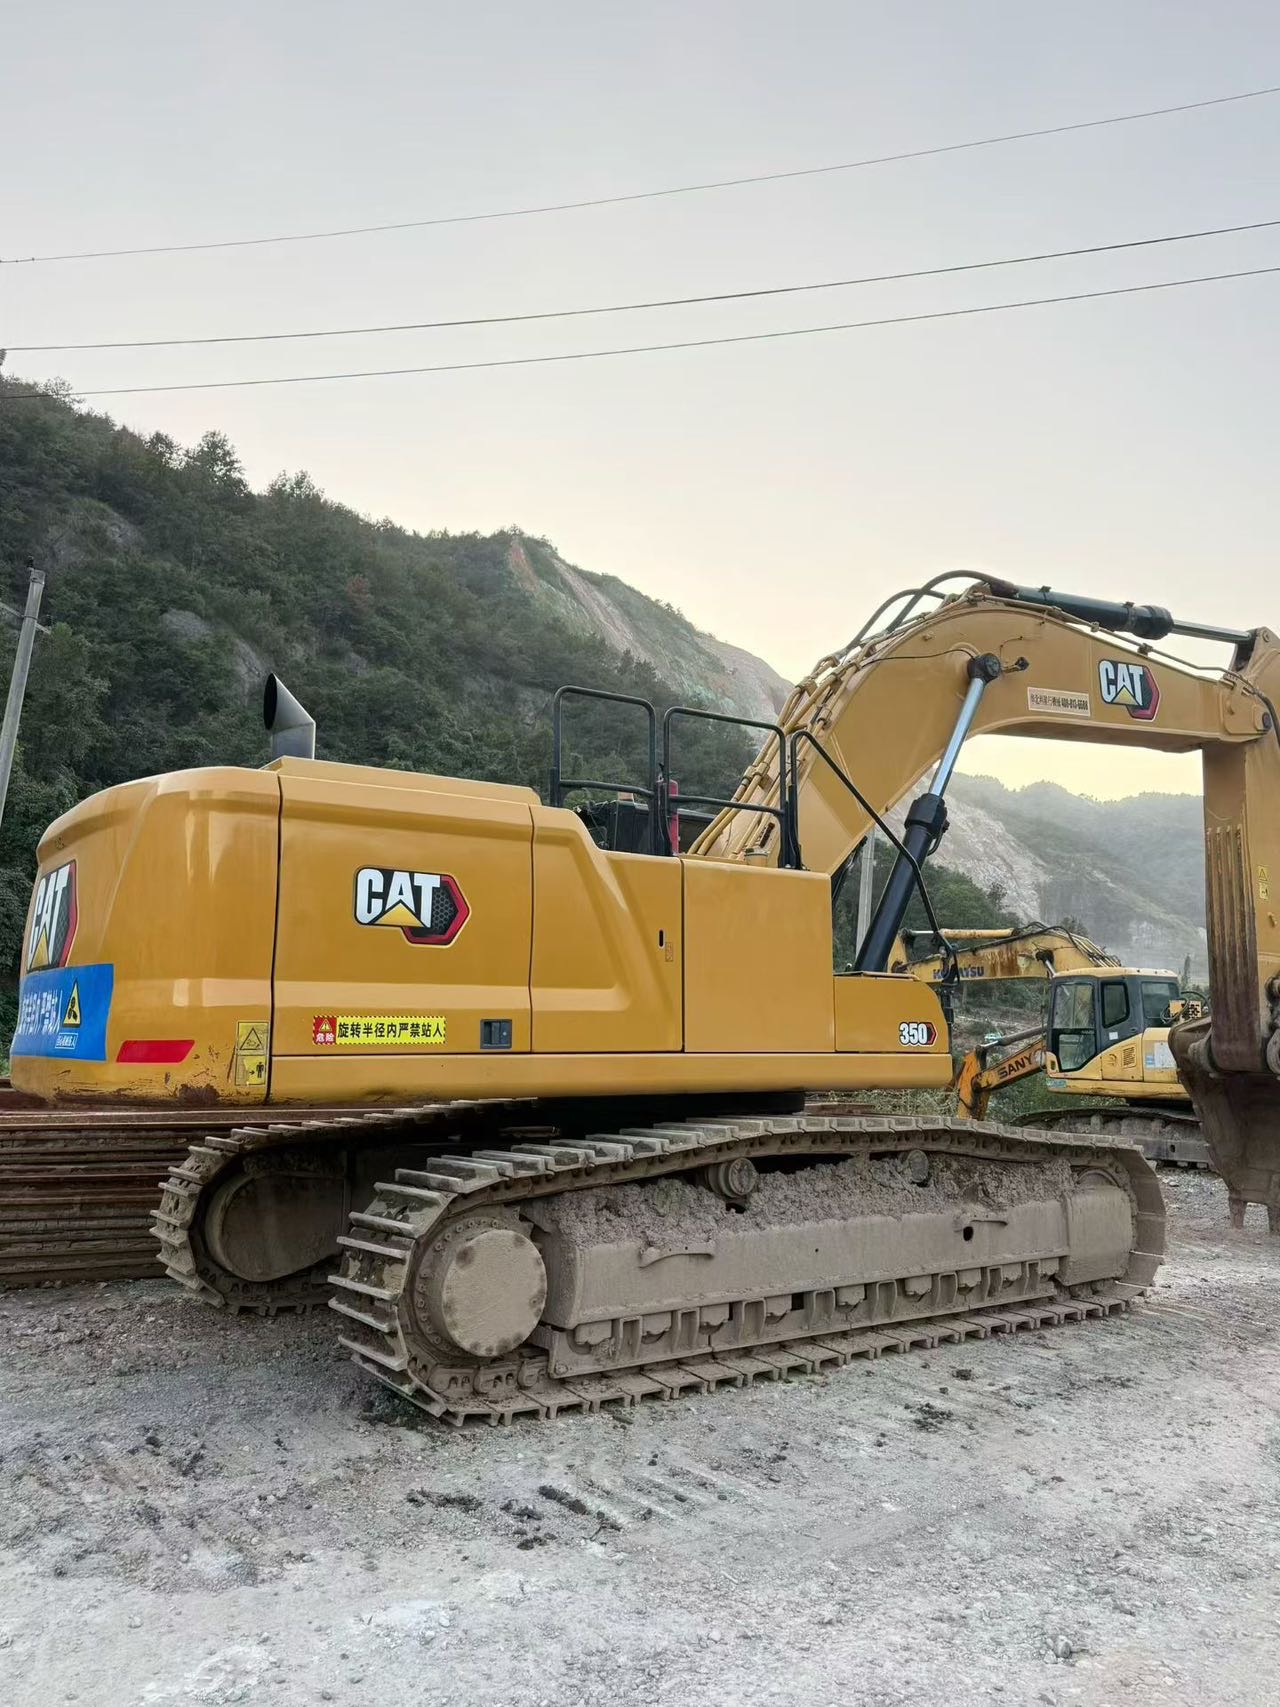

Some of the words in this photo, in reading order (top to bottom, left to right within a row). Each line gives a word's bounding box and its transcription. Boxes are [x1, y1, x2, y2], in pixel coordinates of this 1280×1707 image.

[1099, 660, 1143, 706] CAT
[356, 868, 441, 928] CAT
[27, 864, 71, 970] CAT
[932, 966, 985, 979] KATSU
[316, 1032, 335, 1043] 危险
[337, 1022, 443, 1039] 旋转半径内严禁站人
[899, 1022, 928, 1045] 350
[998, 1052, 1033, 1079] SANY
